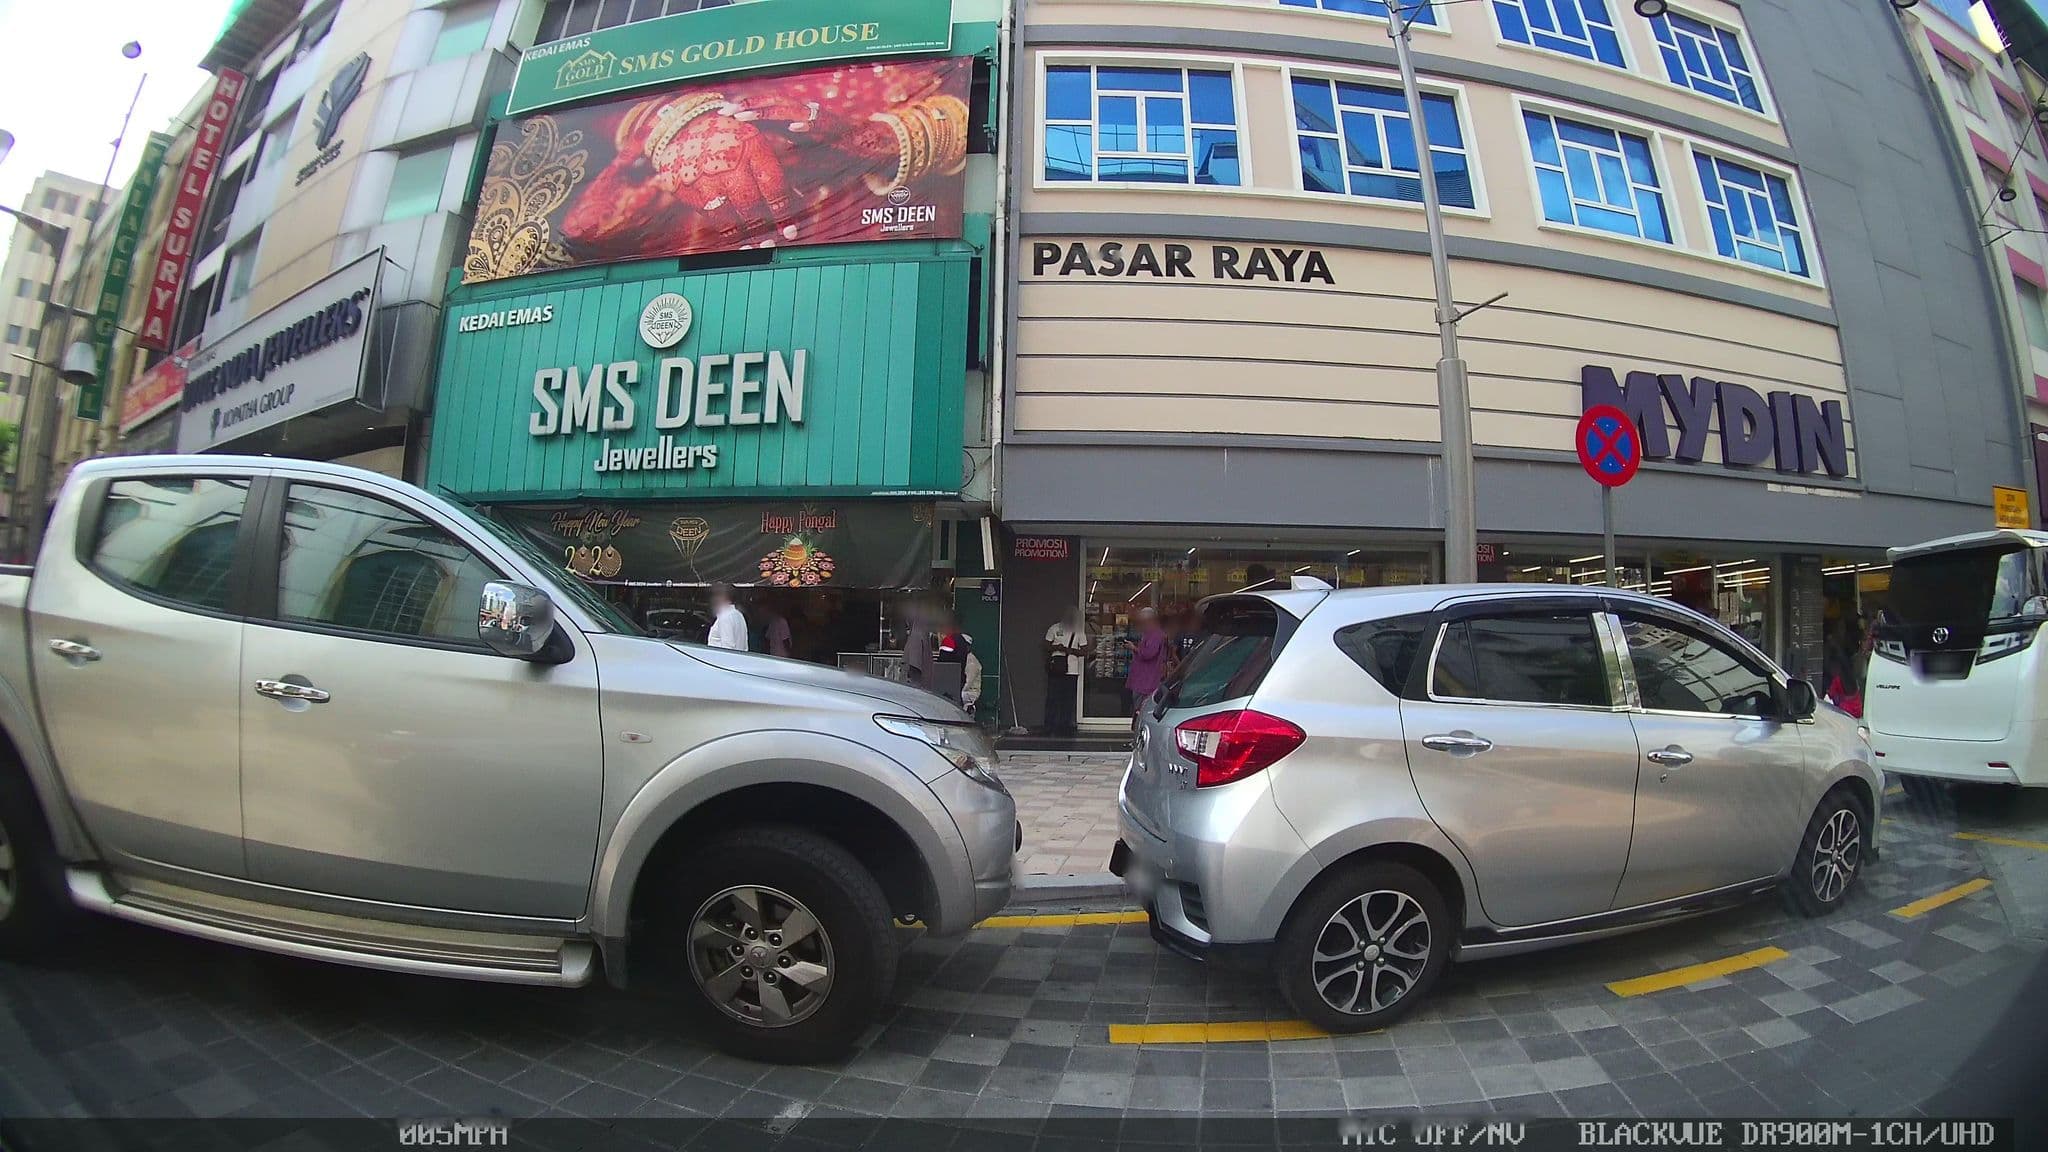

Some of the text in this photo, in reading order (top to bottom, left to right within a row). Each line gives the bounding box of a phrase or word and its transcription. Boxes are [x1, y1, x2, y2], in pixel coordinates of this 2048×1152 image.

[524, 37, 591, 62] KEDAI EMAS
[618, 22, 880, 75] SMS GOLD HOUSE
[565, 64, 605, 81] GOLD
[183, 75, 239, 196] HOTEL
[861, 205, 936, 225] SMS DEEN
[880, 223, 914, 232] Jewellers
[146, 207, 193, 341] SURYA
[1032, 242, 1336, 285] PASAR RAYA
[459, 305, 554, 332] KEDAI EMAS
[656, 321, 674, 330] DEEN
[660, 311, 673, 319] SMS
[259, 383, 296, 414] GROUP
[528, 349, 807, 437] SMS DEEN
[1581, 364, 1849, 478] MYDIN
[593, 435, 718, 472] Jewellers
[611, 509, 640, 536] Year
[676, 525, 702, 537] DEEN
[760, 509, 836, 534] Happy Pongal
